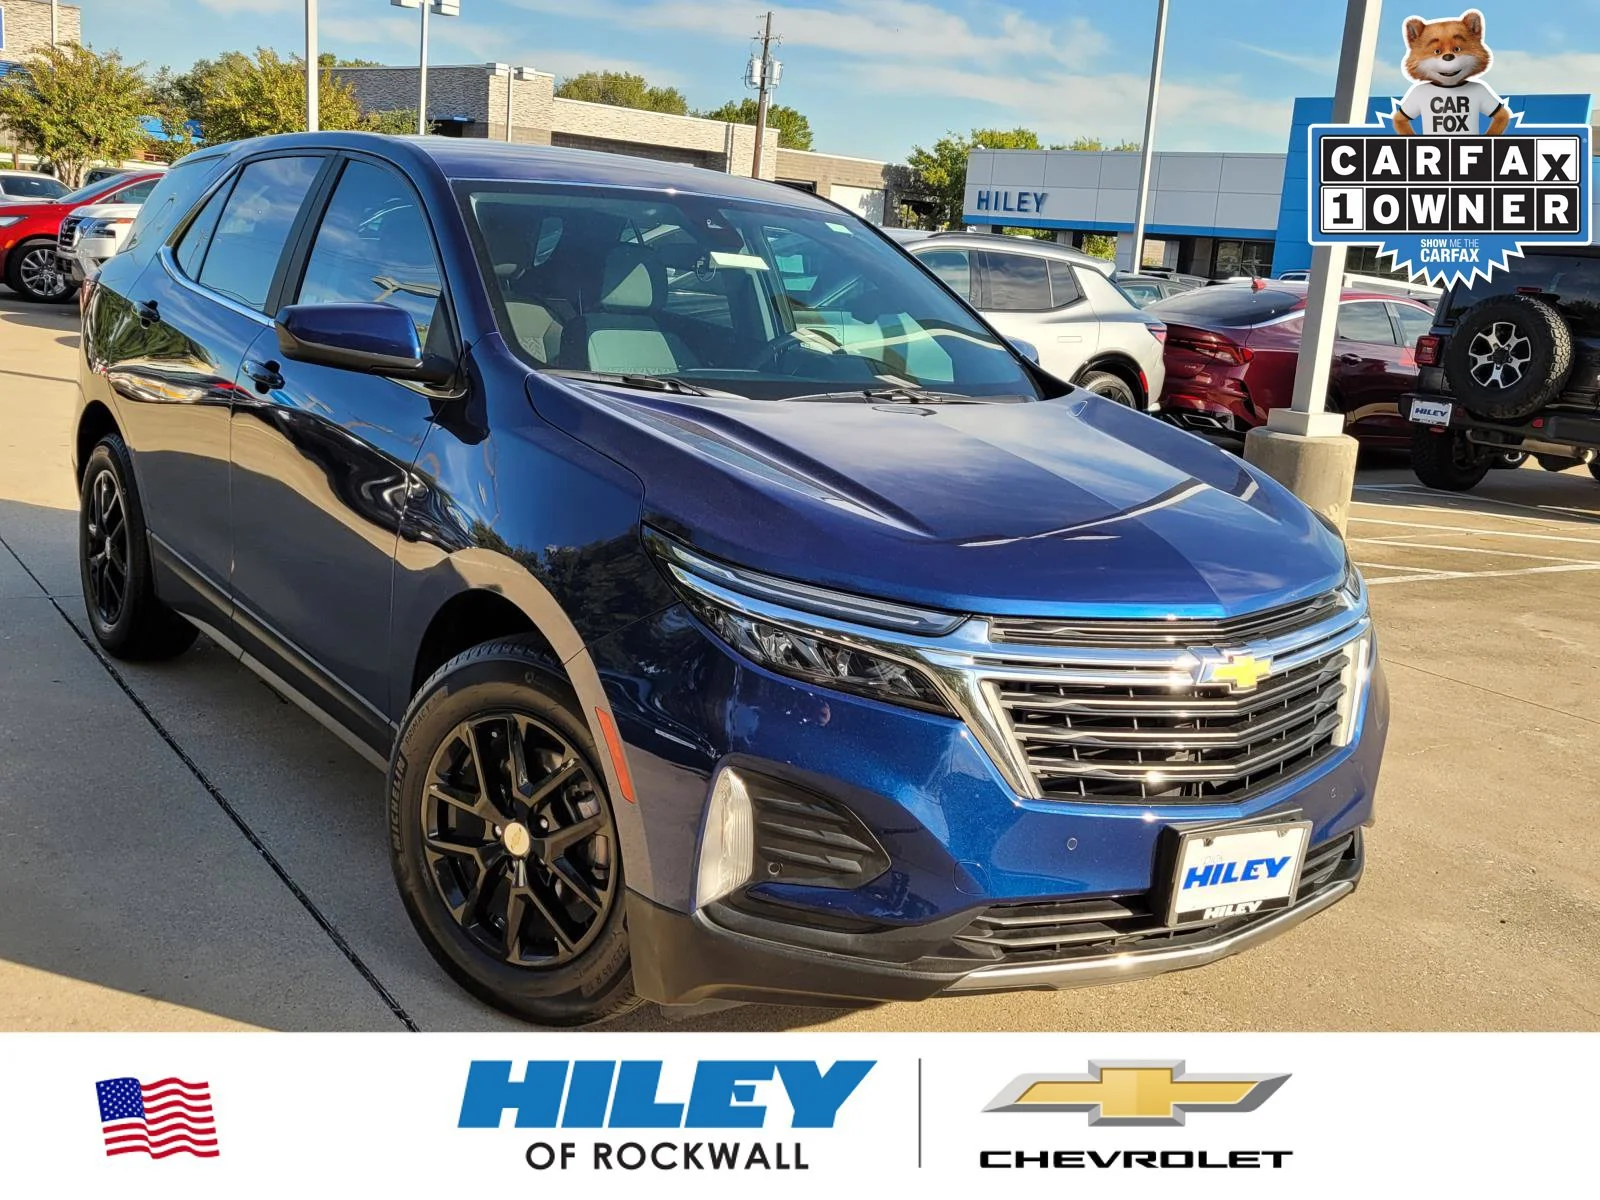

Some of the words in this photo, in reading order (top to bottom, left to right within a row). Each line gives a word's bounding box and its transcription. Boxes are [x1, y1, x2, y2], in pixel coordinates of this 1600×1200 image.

[977, 190, 1049, 213] HILEY
[1415, 407, 1448, 417] HILEY
[391, 756, 408, 851] MICHELIN
[1182, 856, 1292, 890] HILEY
[1203, 900, 1264, 920] HILEY
